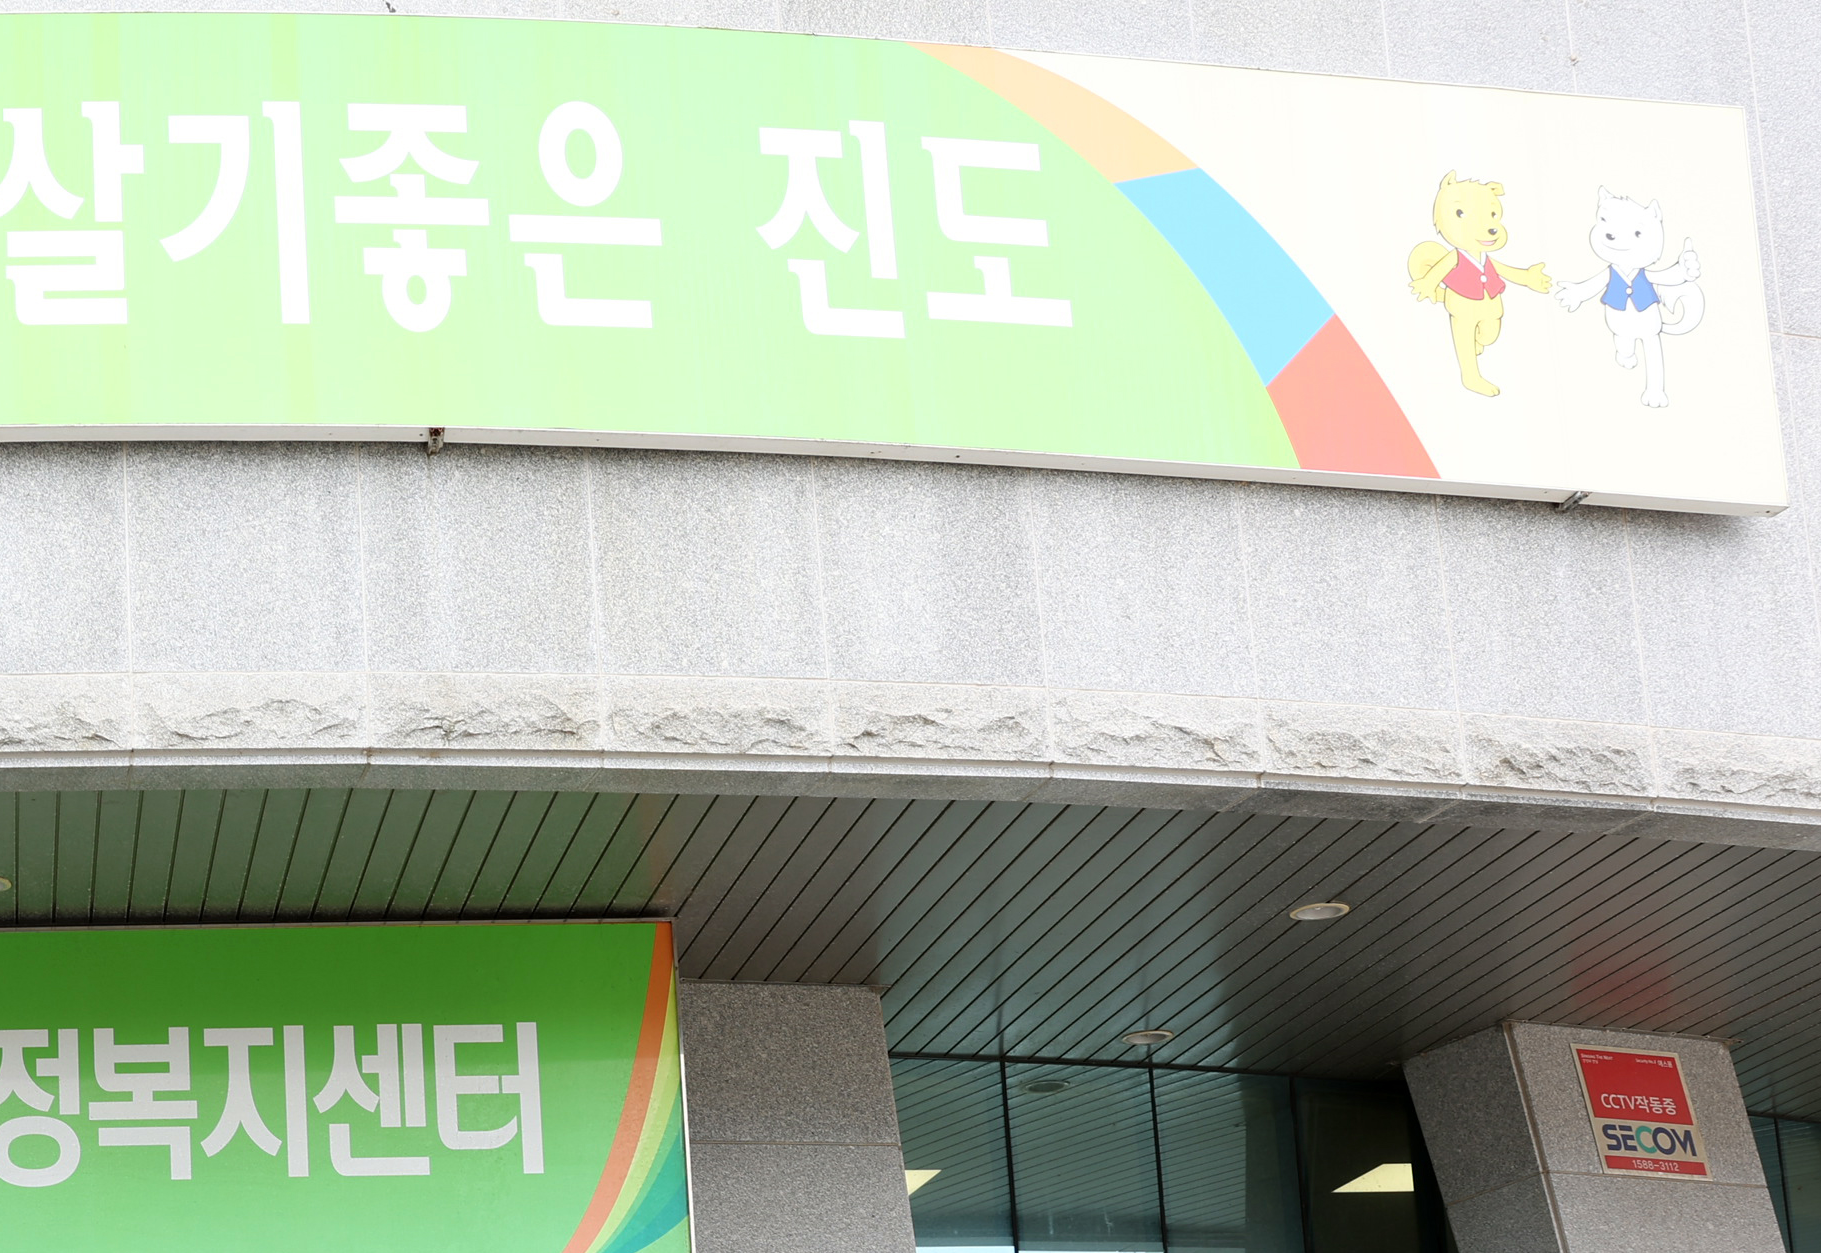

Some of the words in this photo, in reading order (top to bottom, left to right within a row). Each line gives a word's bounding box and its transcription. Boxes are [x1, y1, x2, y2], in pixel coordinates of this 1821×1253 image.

[756, 120, 1074, 339] 진도
[1601, 1094, 1676, 1115] CCTV작동중
[1602, 1124, 1697, 1156] SECOM
[1632, 1160, 1679, 1171] 1588-3112
